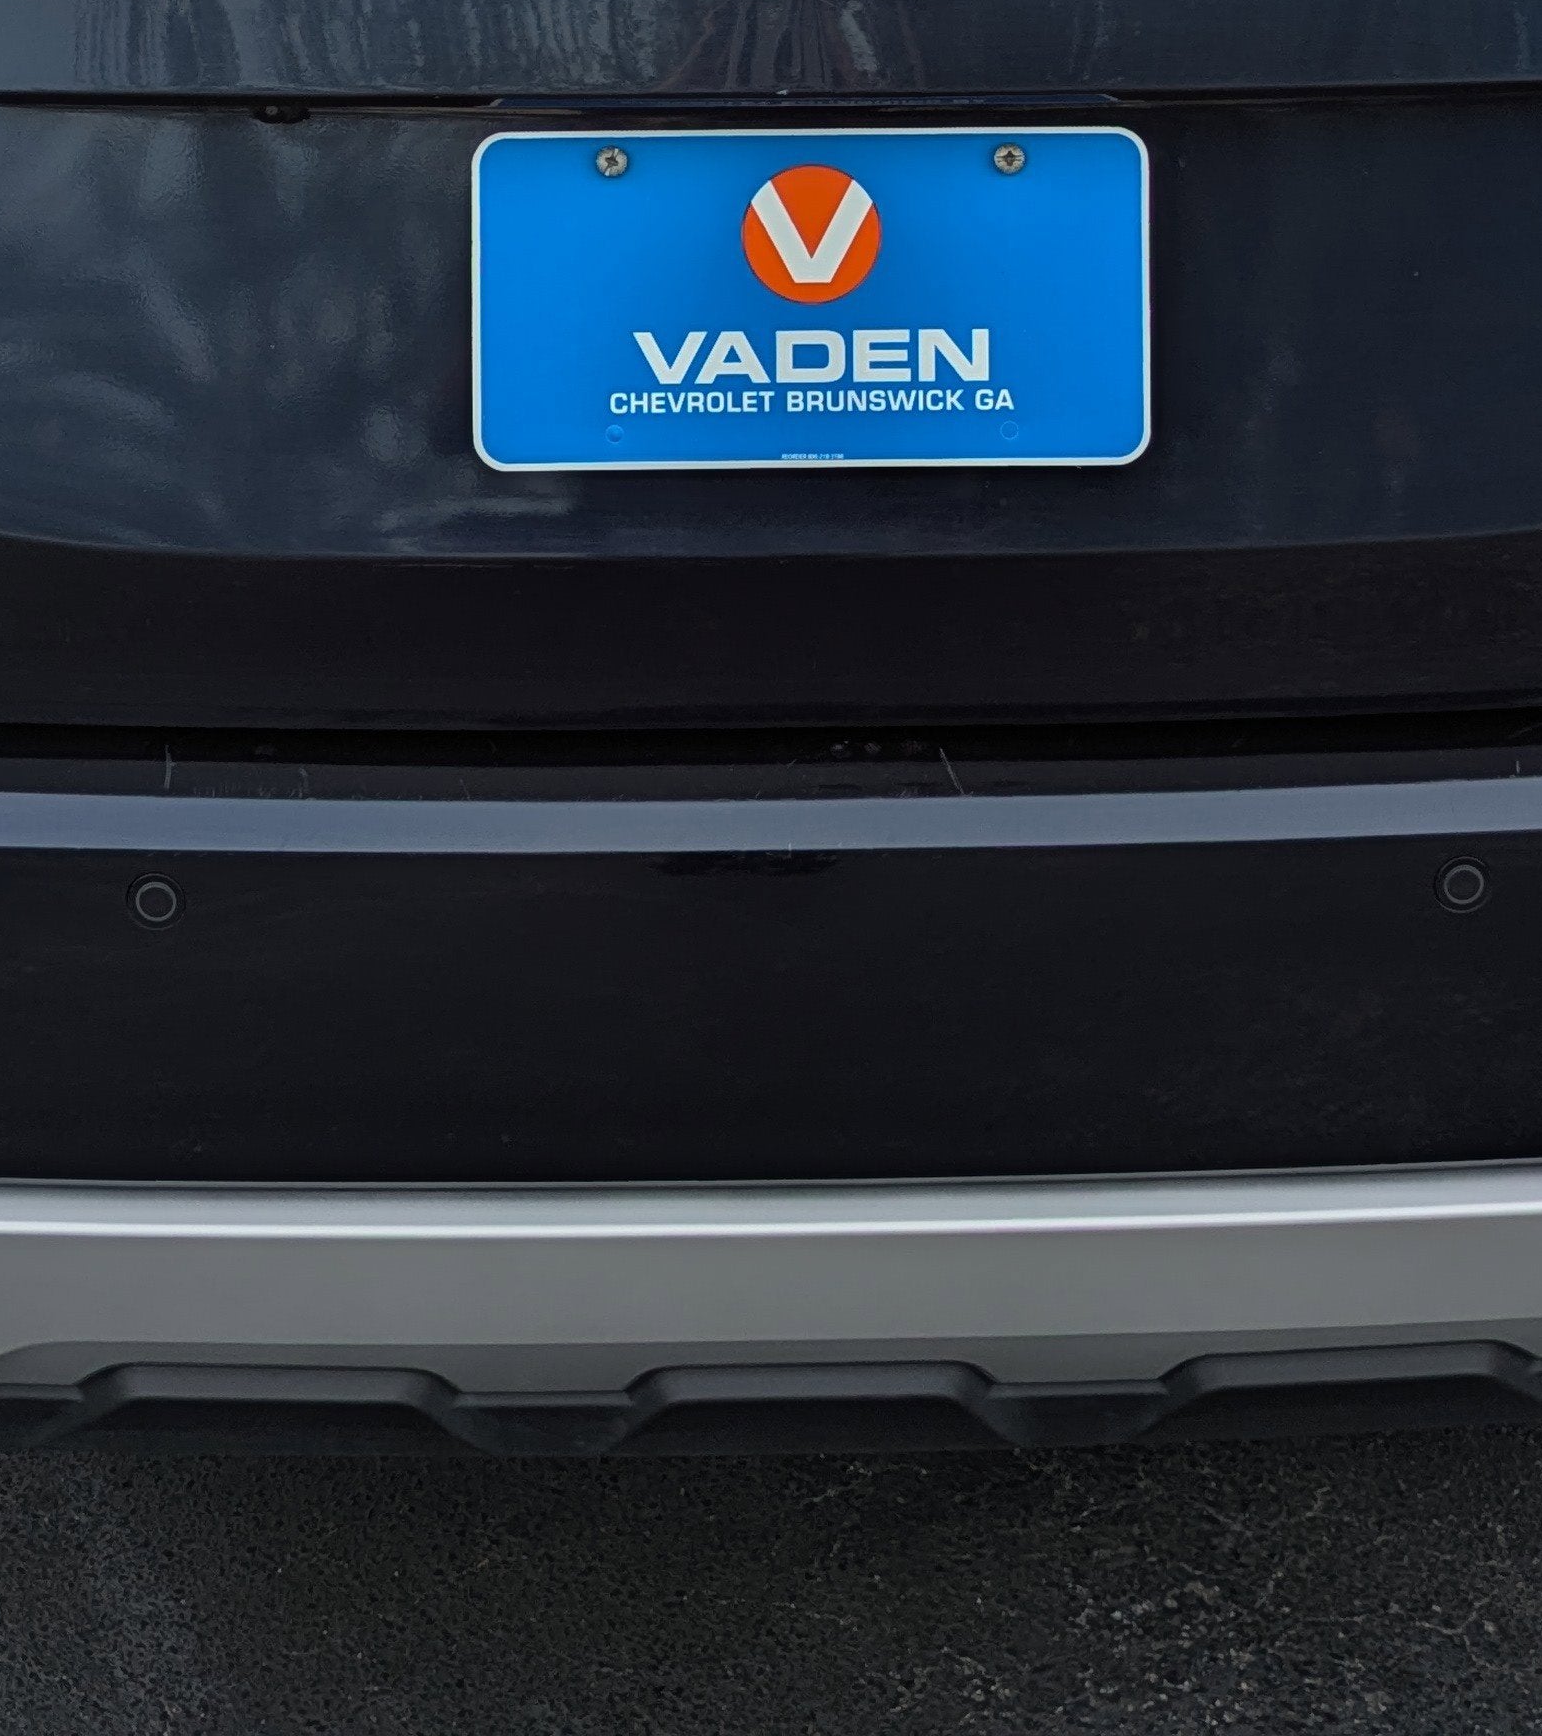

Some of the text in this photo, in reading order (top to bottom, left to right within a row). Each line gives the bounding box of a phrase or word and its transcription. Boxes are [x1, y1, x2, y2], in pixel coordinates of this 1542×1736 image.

[750, 178, 874, 284] V
[633, 328, 990, 385] VADEN
[609, 388, 1015, 415] CHEVROLET BRUNSWICK GA
